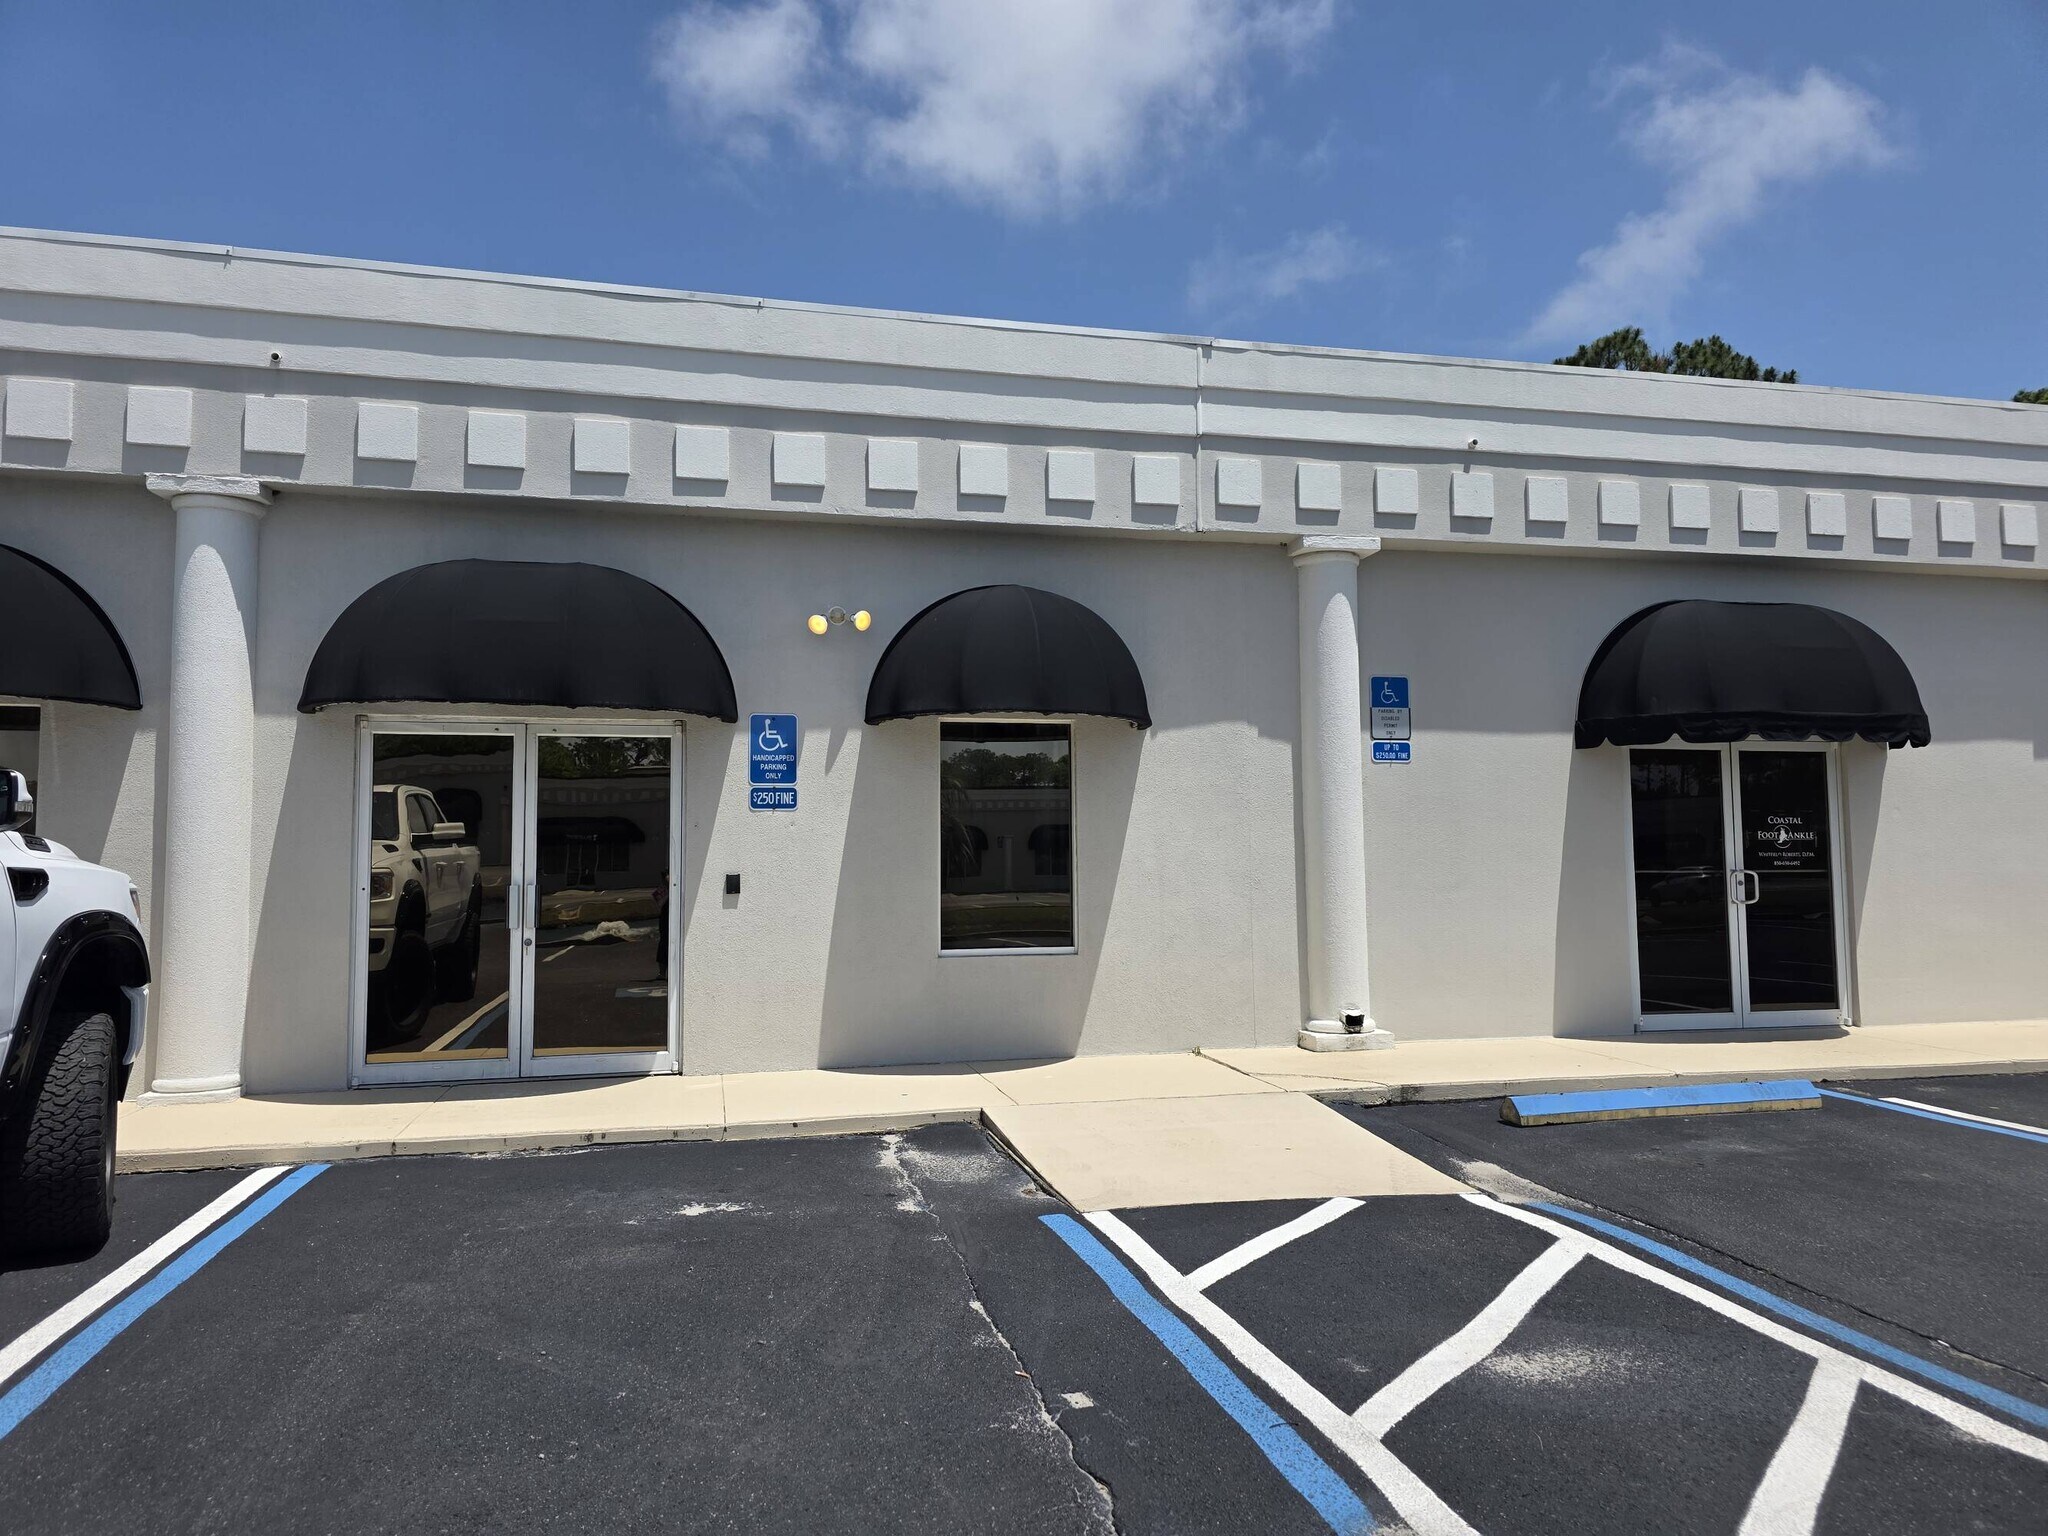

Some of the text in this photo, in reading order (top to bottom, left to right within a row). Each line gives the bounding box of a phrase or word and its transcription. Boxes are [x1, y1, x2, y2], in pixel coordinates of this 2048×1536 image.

[752, 754, 795, 762] HANDICAPPED
[760, 763, 787, 771] PARKING
[752, 792, 795, 805] $250 FINE
[1768, 816, 1803, 824] COASTAL
[1758, 830, 1814, 840] FOOT ANKLE
